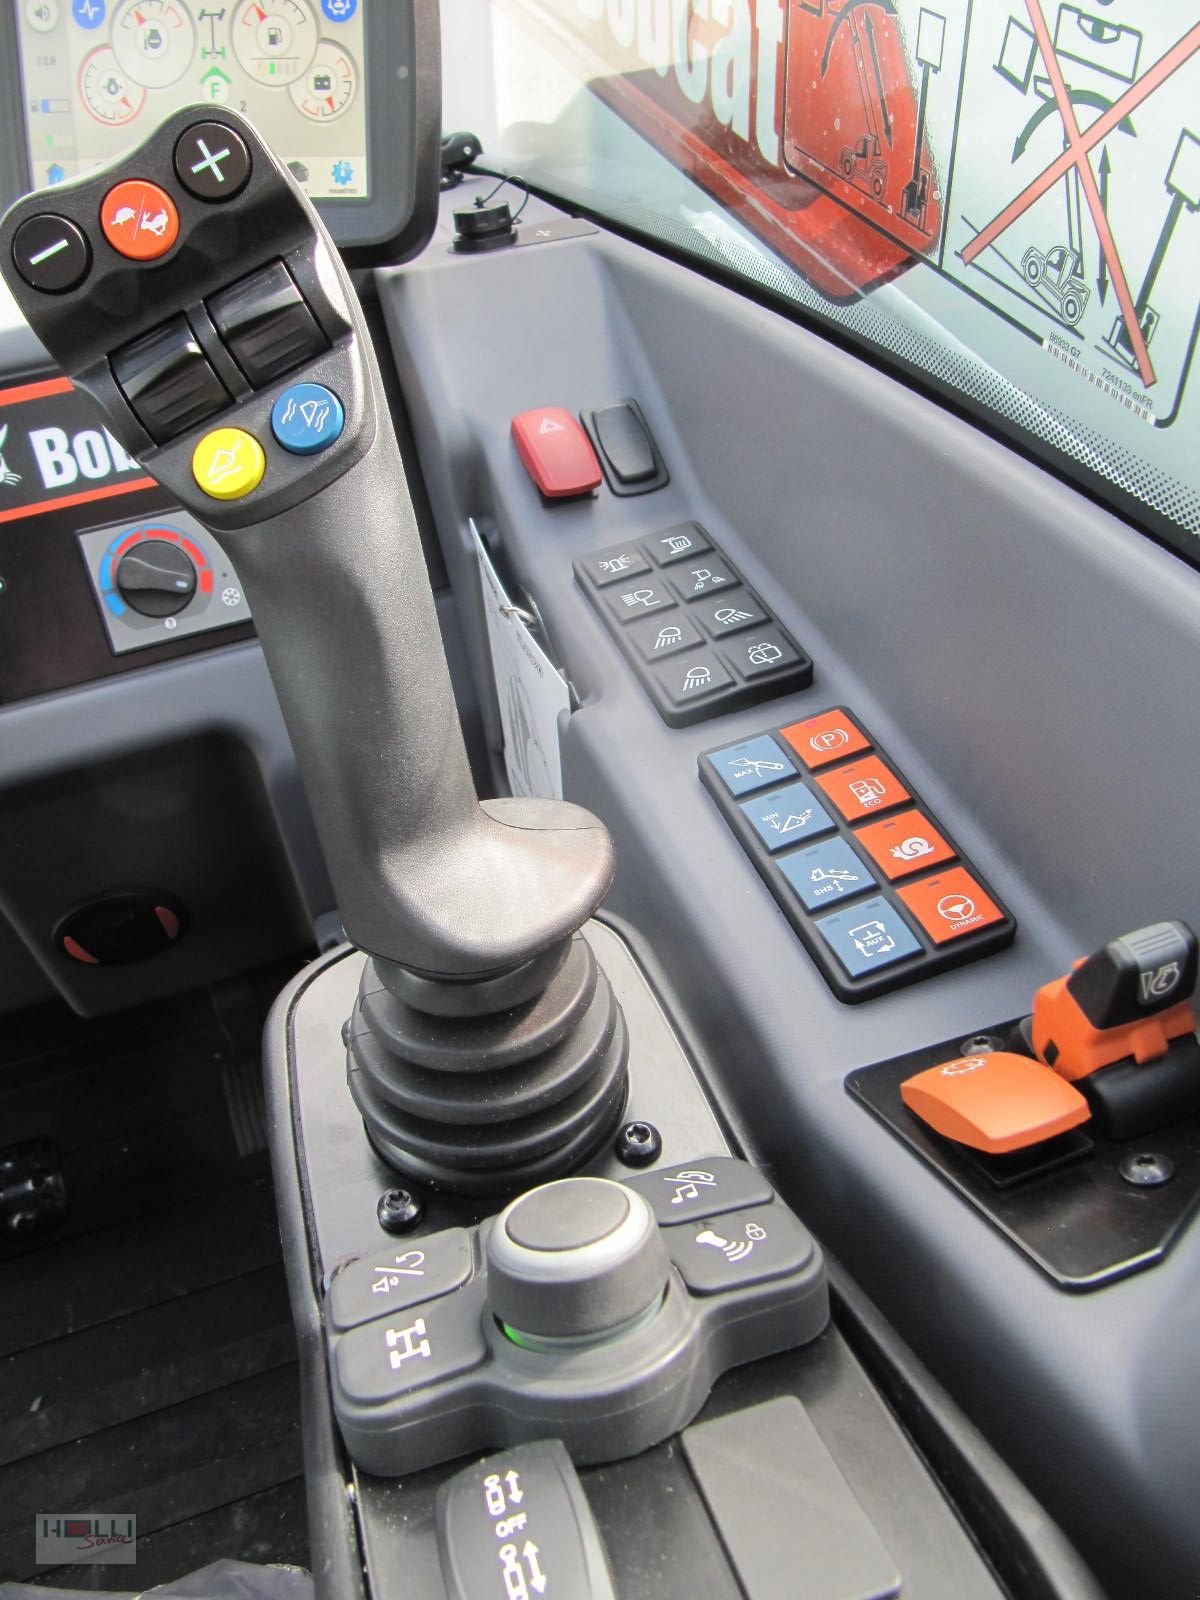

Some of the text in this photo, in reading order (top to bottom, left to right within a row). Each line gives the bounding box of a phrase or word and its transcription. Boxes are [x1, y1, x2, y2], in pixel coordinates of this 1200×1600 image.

[211, 82, 221, 98] F
[733, 768, 754, 779] MAX
[863, 798, 882, 808] ECO
[761, 811, 780, 823] MIN
[813, 884, 834, 897] SHS
[949, 914, 984, 931] DYNAMIC
[866, 936, 885, 948] AUX
[495, 1512, 526, 1538] OFF
